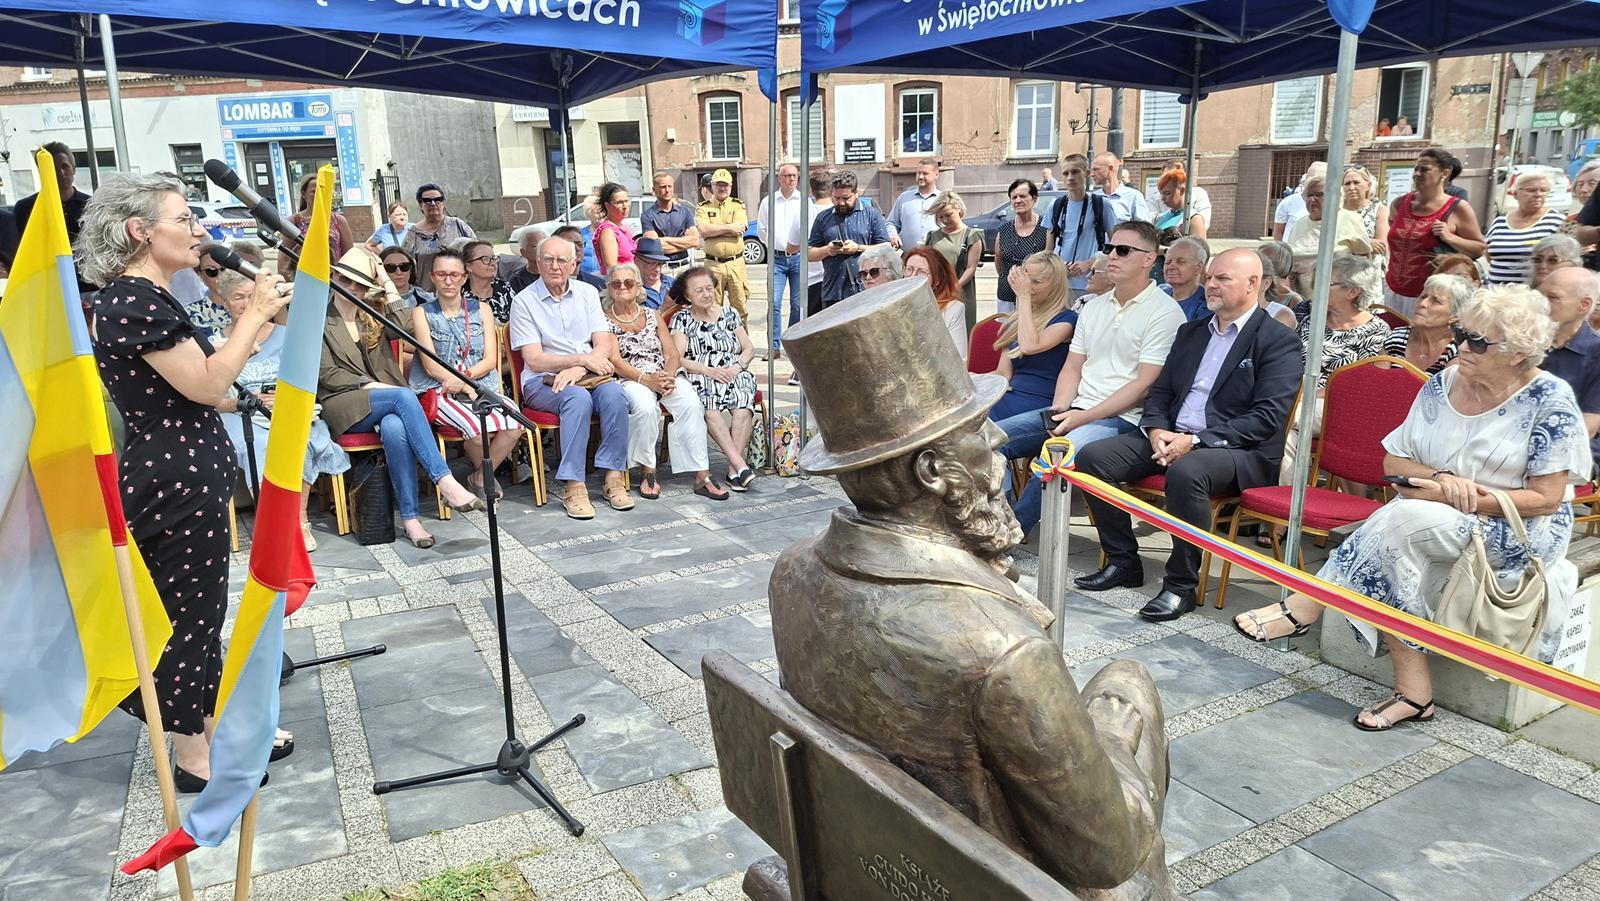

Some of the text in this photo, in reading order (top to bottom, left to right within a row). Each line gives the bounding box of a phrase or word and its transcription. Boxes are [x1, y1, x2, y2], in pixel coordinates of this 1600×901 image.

[918, 0, 1086, 35] w Świętocow
[1569, 603, 1586, 619] ZAKAZ
[874, 854, 918, 897] GUIDO
